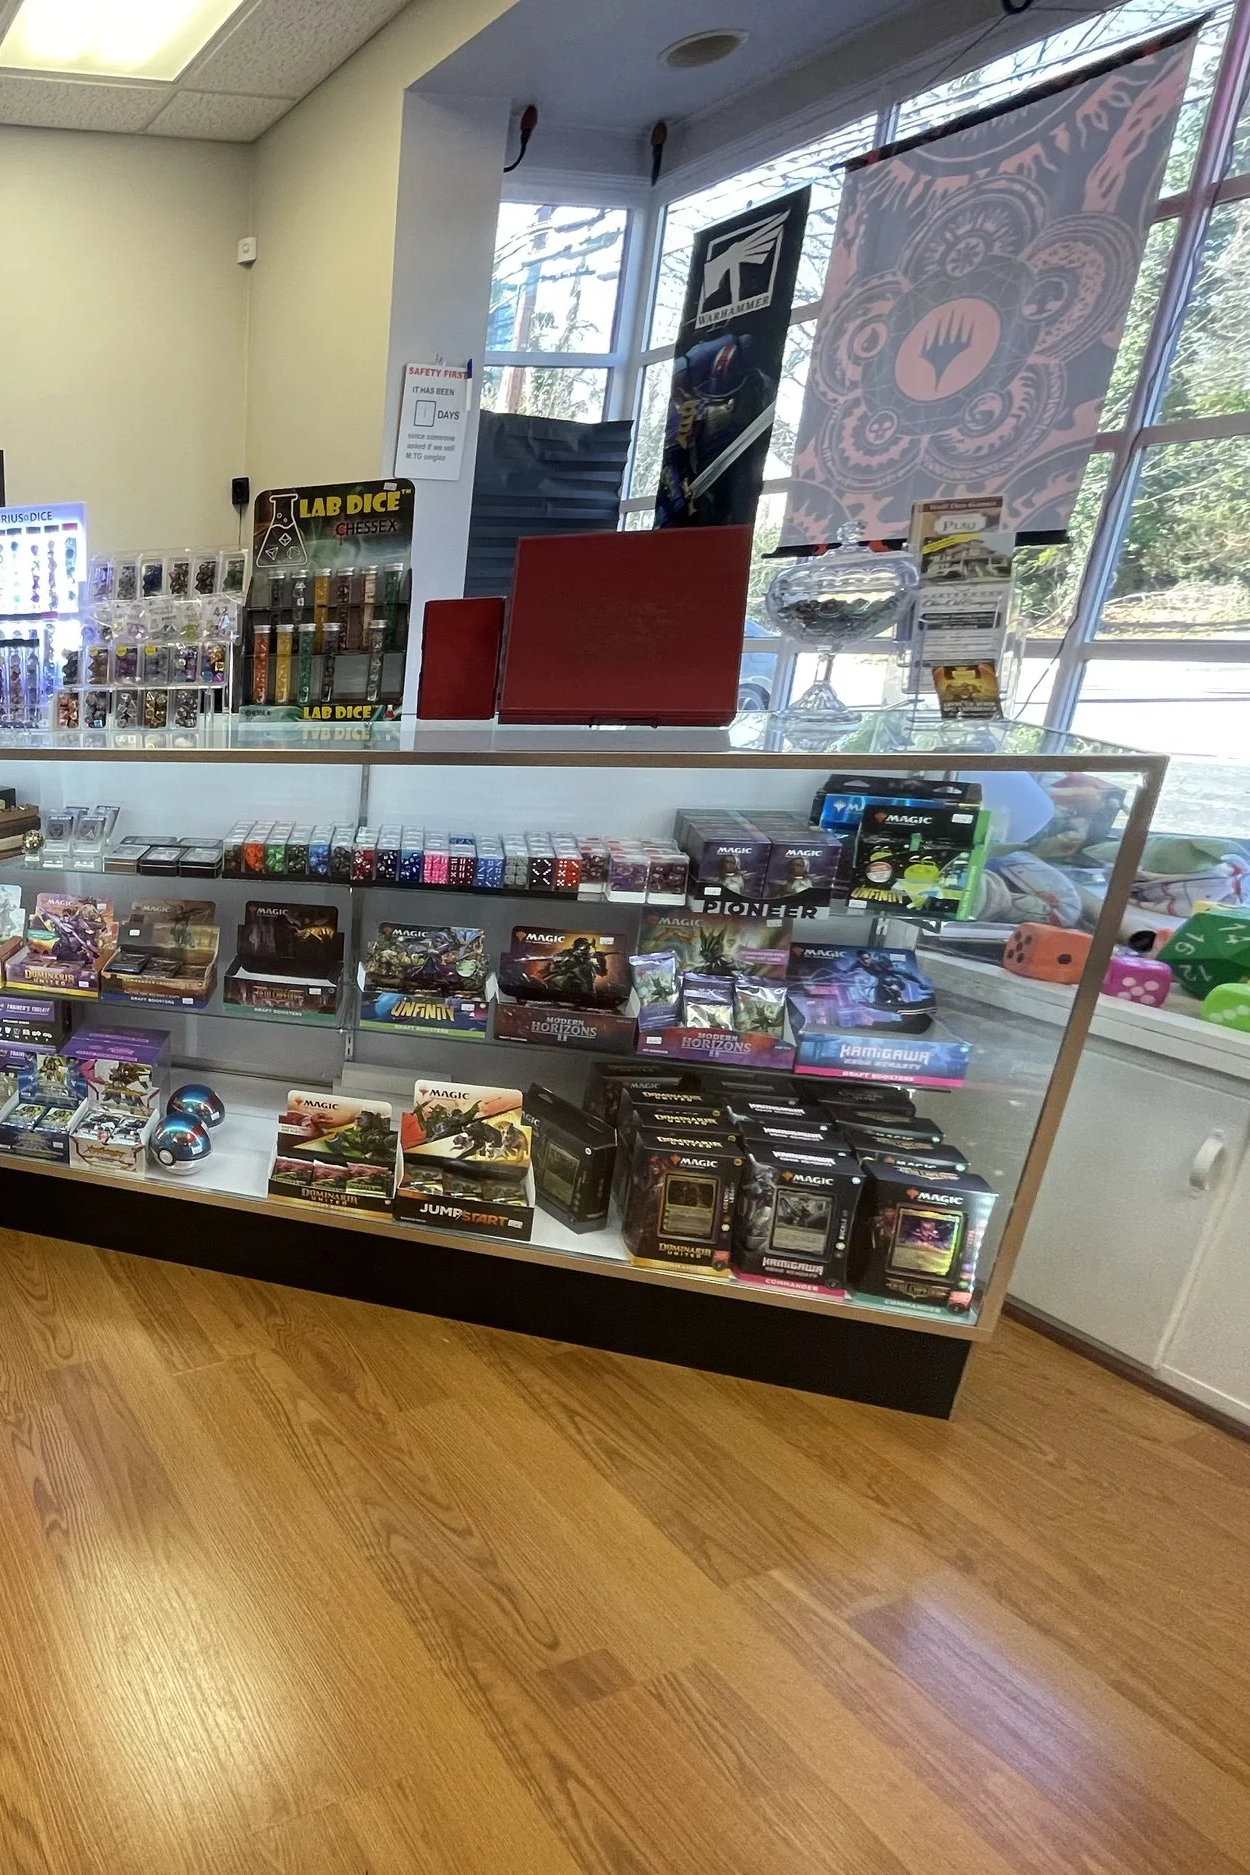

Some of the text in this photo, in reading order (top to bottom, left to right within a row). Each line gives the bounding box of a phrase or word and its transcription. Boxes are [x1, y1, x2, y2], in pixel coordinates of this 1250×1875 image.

[698, 296, 770, 325] WARHAMMER
[408, 367, 468, 380] SAFETY FIRST
[420, 387, 435, 395] HAS
[436, 387, 455, 396] BEEN
[437, 410, 460, 421] DAYS
[300, 496, 341, 518] LAB
[335, 519, 397, 540] CHESSEX
[303, 706, 331, 720] LAB
[885, 814, 933, 825] MAGIC
[717, 847, 753, 855] MAGIC
[785, 849, 823, 857] MAGIC
[47, 899, 75, 907] MAGIC
[142, 905, 171, 913] MAGIC
[257, 907, 290, 915] MAGIC
[703, 900, 818, 919] PIONEER
[658, 917, 704, 927] MAGIC
[392, 928, 430, 938] MAGIC
[525, 933, 566, 943] MAGIC
[803, 948, 848, 958] MAGIC
[391, 1001, 455, 1022] UNFINITY
[546, 1016, 585, 1026] MODERN
[531, 1021, 598, 1037] HORIZONS
[697, 1032, 738, 1042] MODERN
[681, 1036, 752, 1052] HORIZONS
[840, 1045, 931, 1066] KAMIGAWA
[871, 1072, 915, 1082] BOOSTERS
[429, 1089, 471, 1101] MAGIC
[303, 1099, 339, 1110] MAGIC
[680, 1157, 719, 1168] MAGIC
[792, 1174, 835, 1186] MAGIC
[311, 1195, 348, 1206] UNITED
[918, 1192, 964, 1205] MAGIC
[762, 1256, 824, 1276] KAMIGAWA
[765, 1278, 819, 1292] COMMANDER
[884, 1299, 942, 1313] COMMANDER
